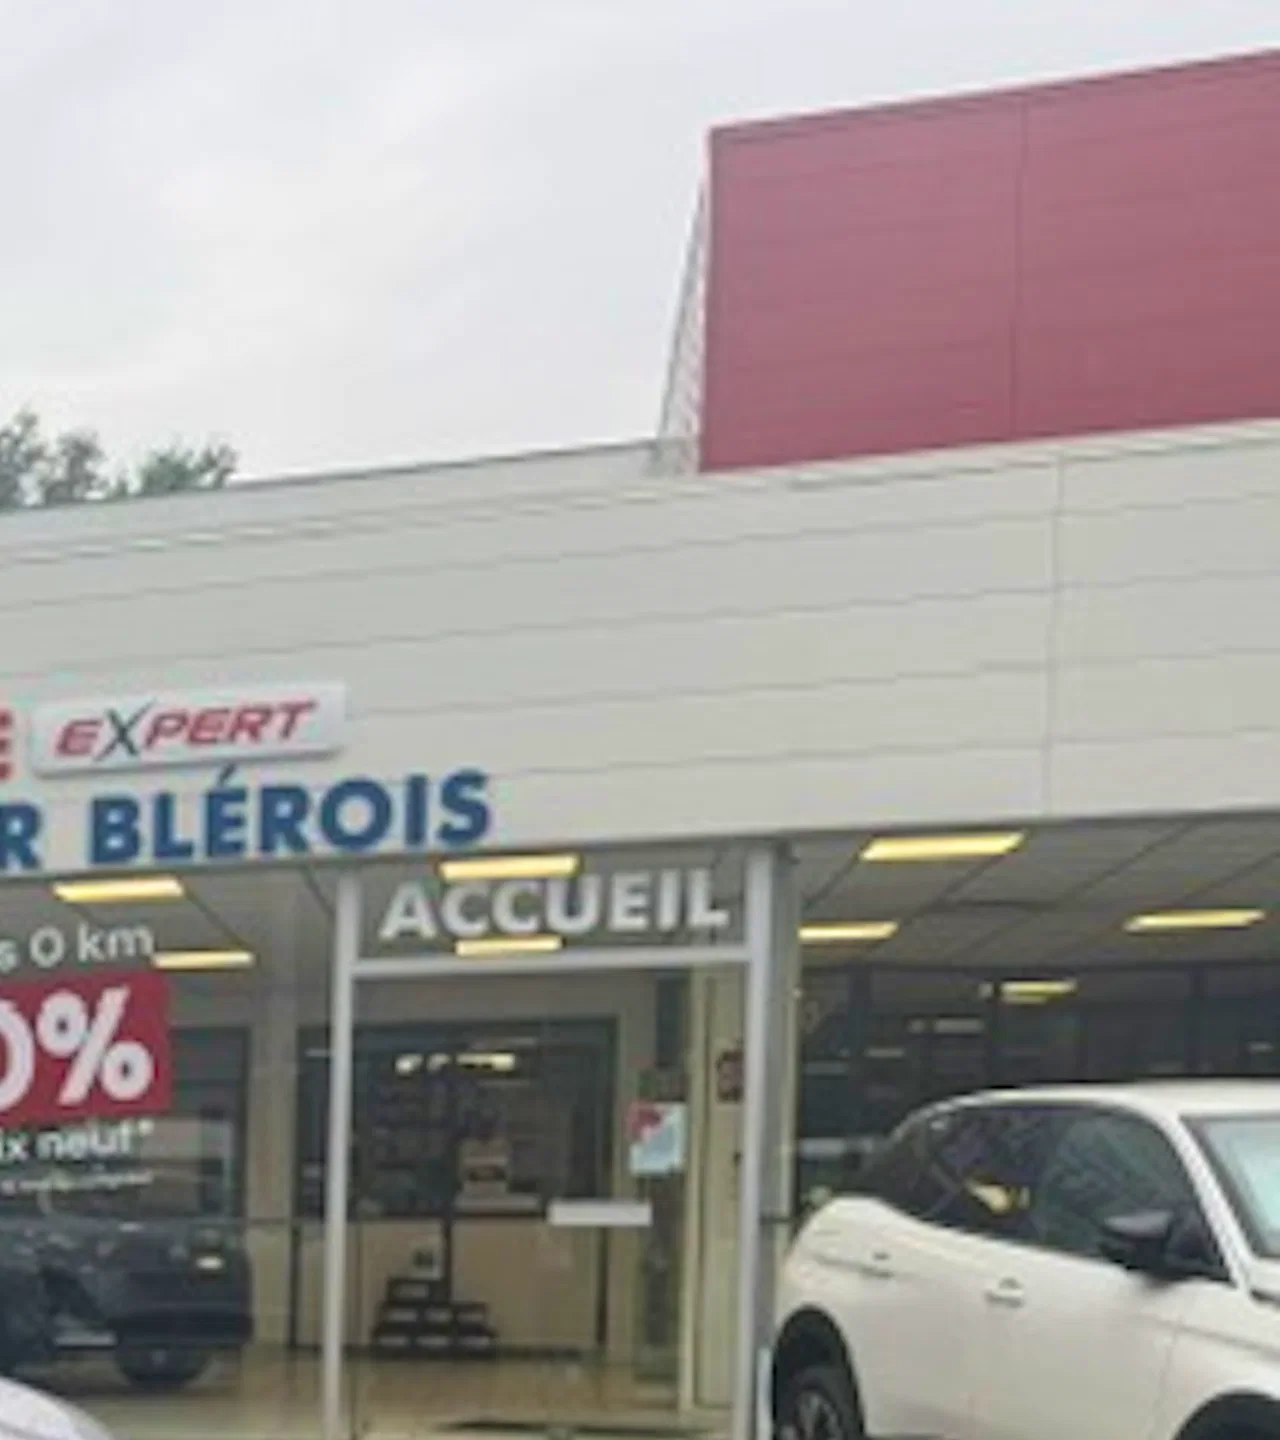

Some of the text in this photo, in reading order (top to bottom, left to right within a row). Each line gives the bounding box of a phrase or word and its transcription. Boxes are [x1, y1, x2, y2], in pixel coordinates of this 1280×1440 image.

[89, 765, 493, 866] BLÉROIS
[379, 868, 729, 940] ACCUEIL
[77, 922, 155, 963] km
